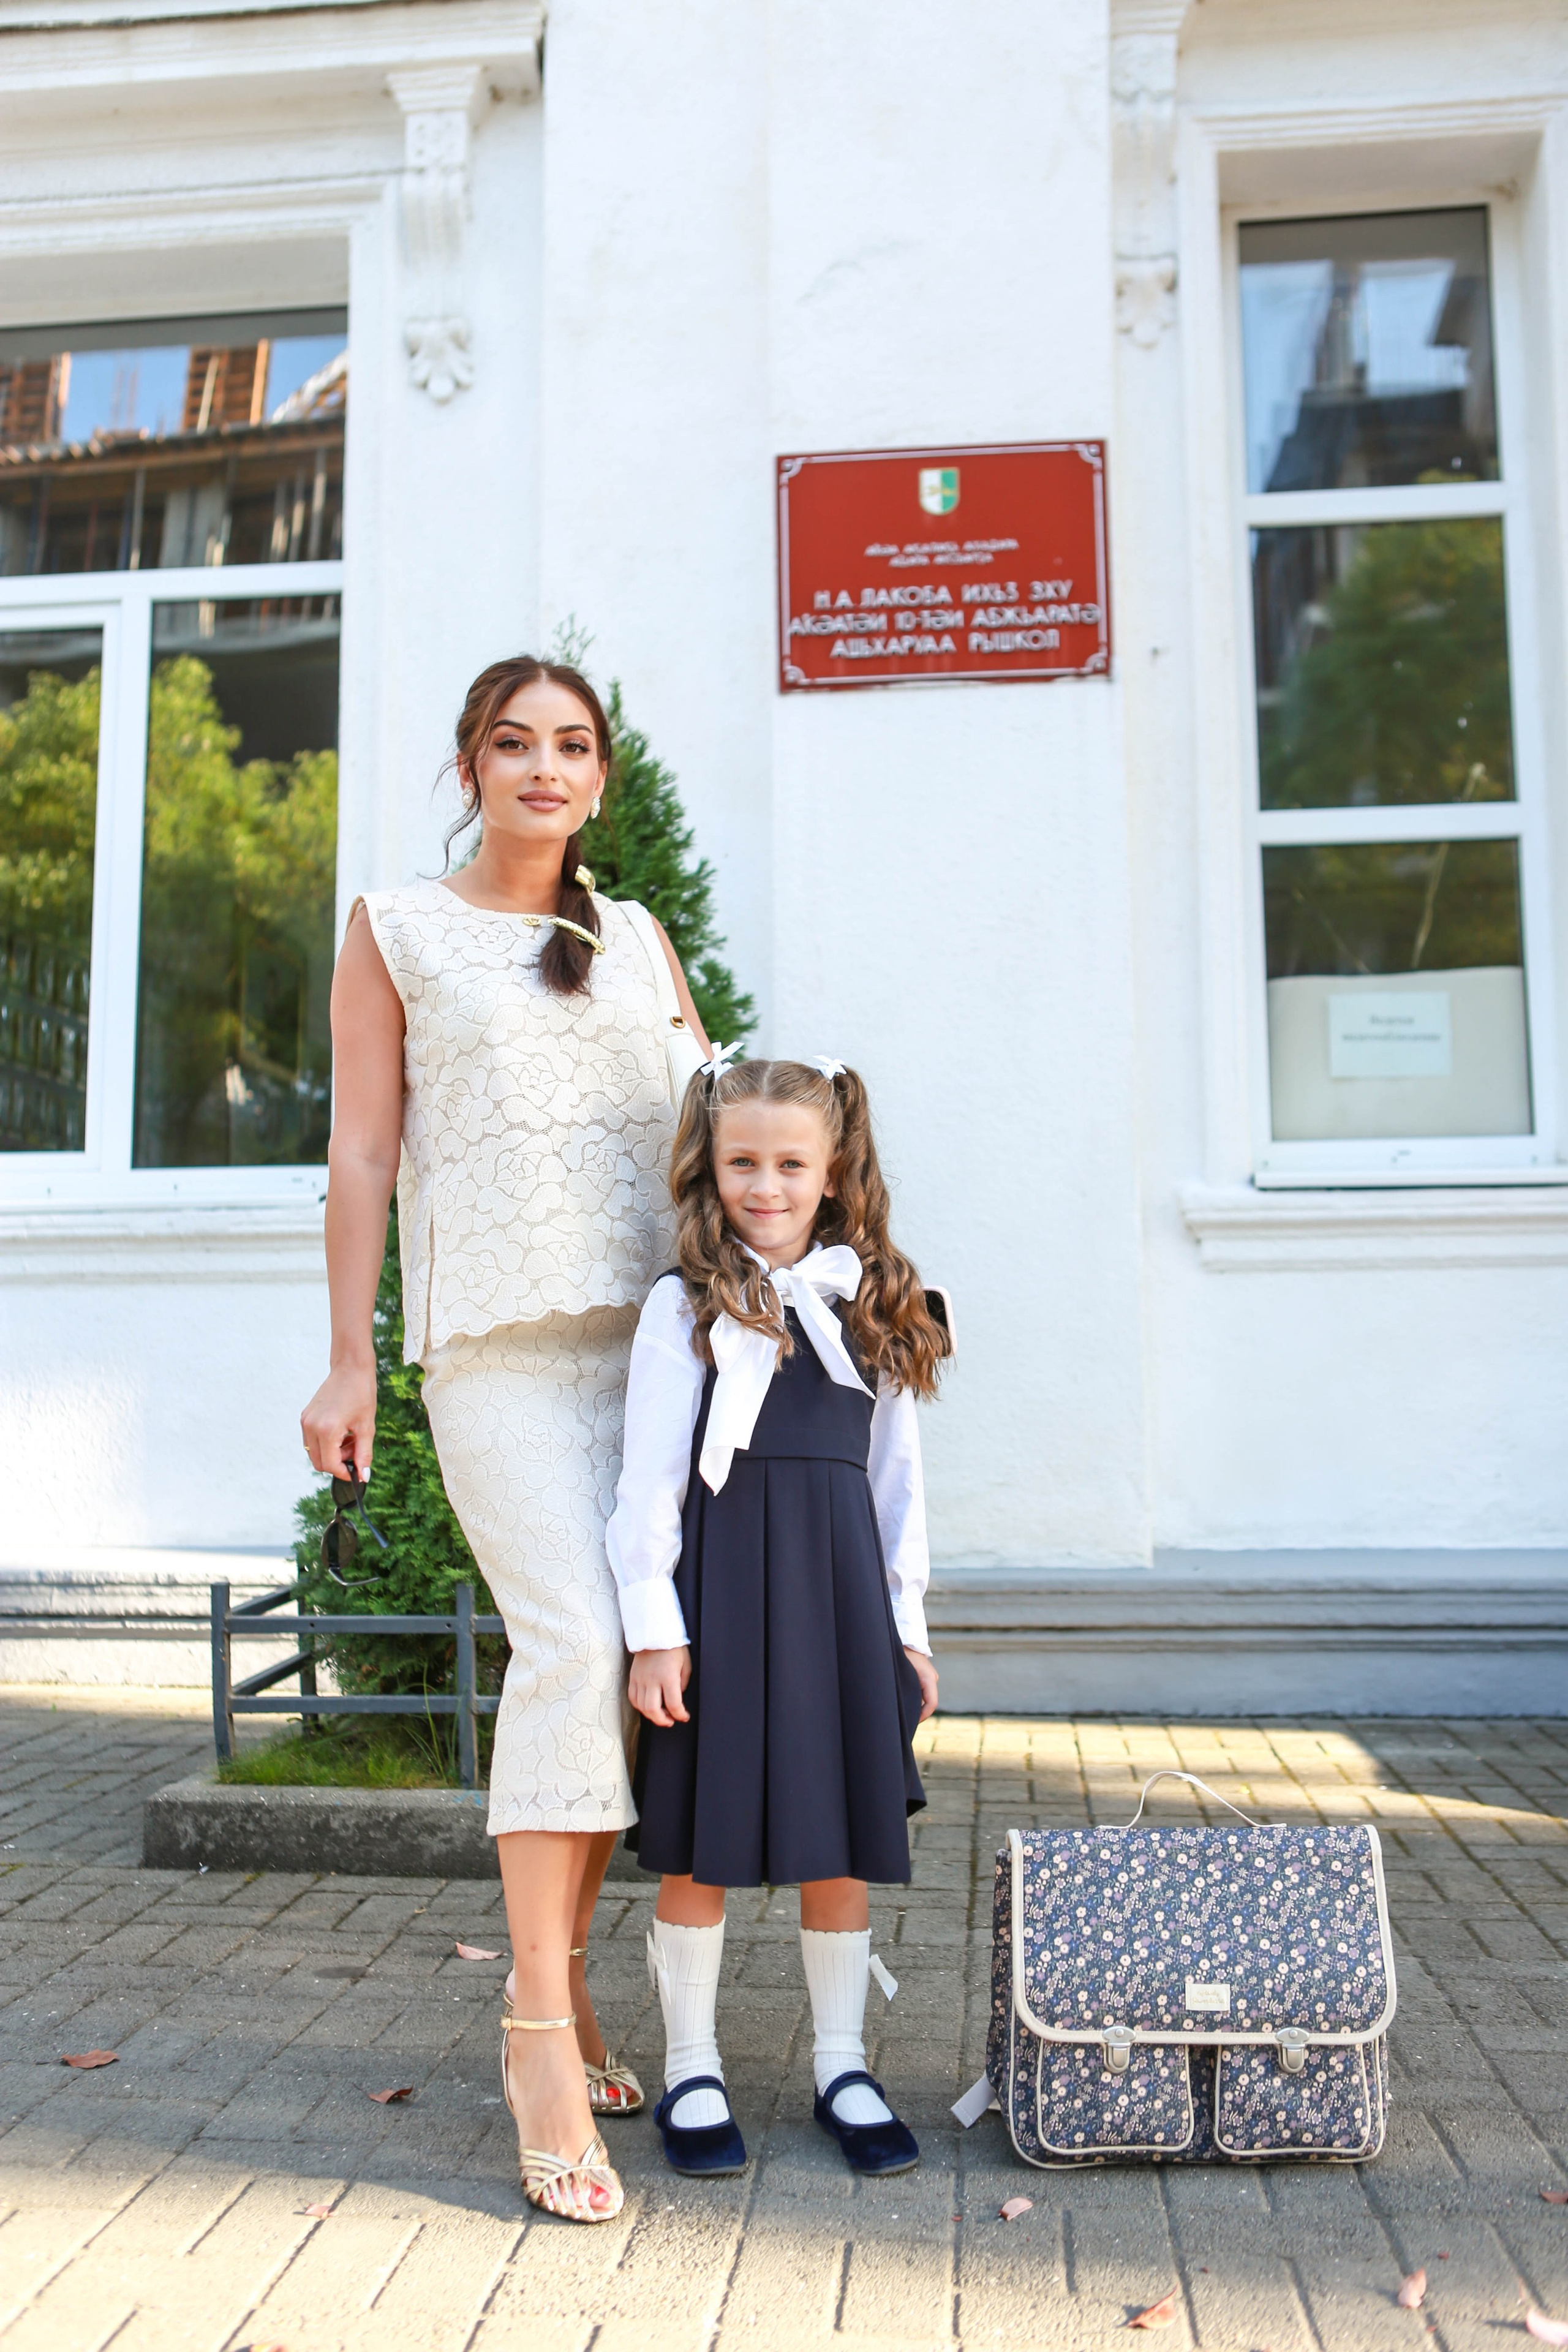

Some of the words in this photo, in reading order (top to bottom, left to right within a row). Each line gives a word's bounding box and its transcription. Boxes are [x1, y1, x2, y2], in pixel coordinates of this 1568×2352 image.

[859, 585, 952, 608] ЛАКОБА
[1028, 578, 1073, 601] ЗХУ
[968, 629, 1060, 654] РЫШКОЛ
